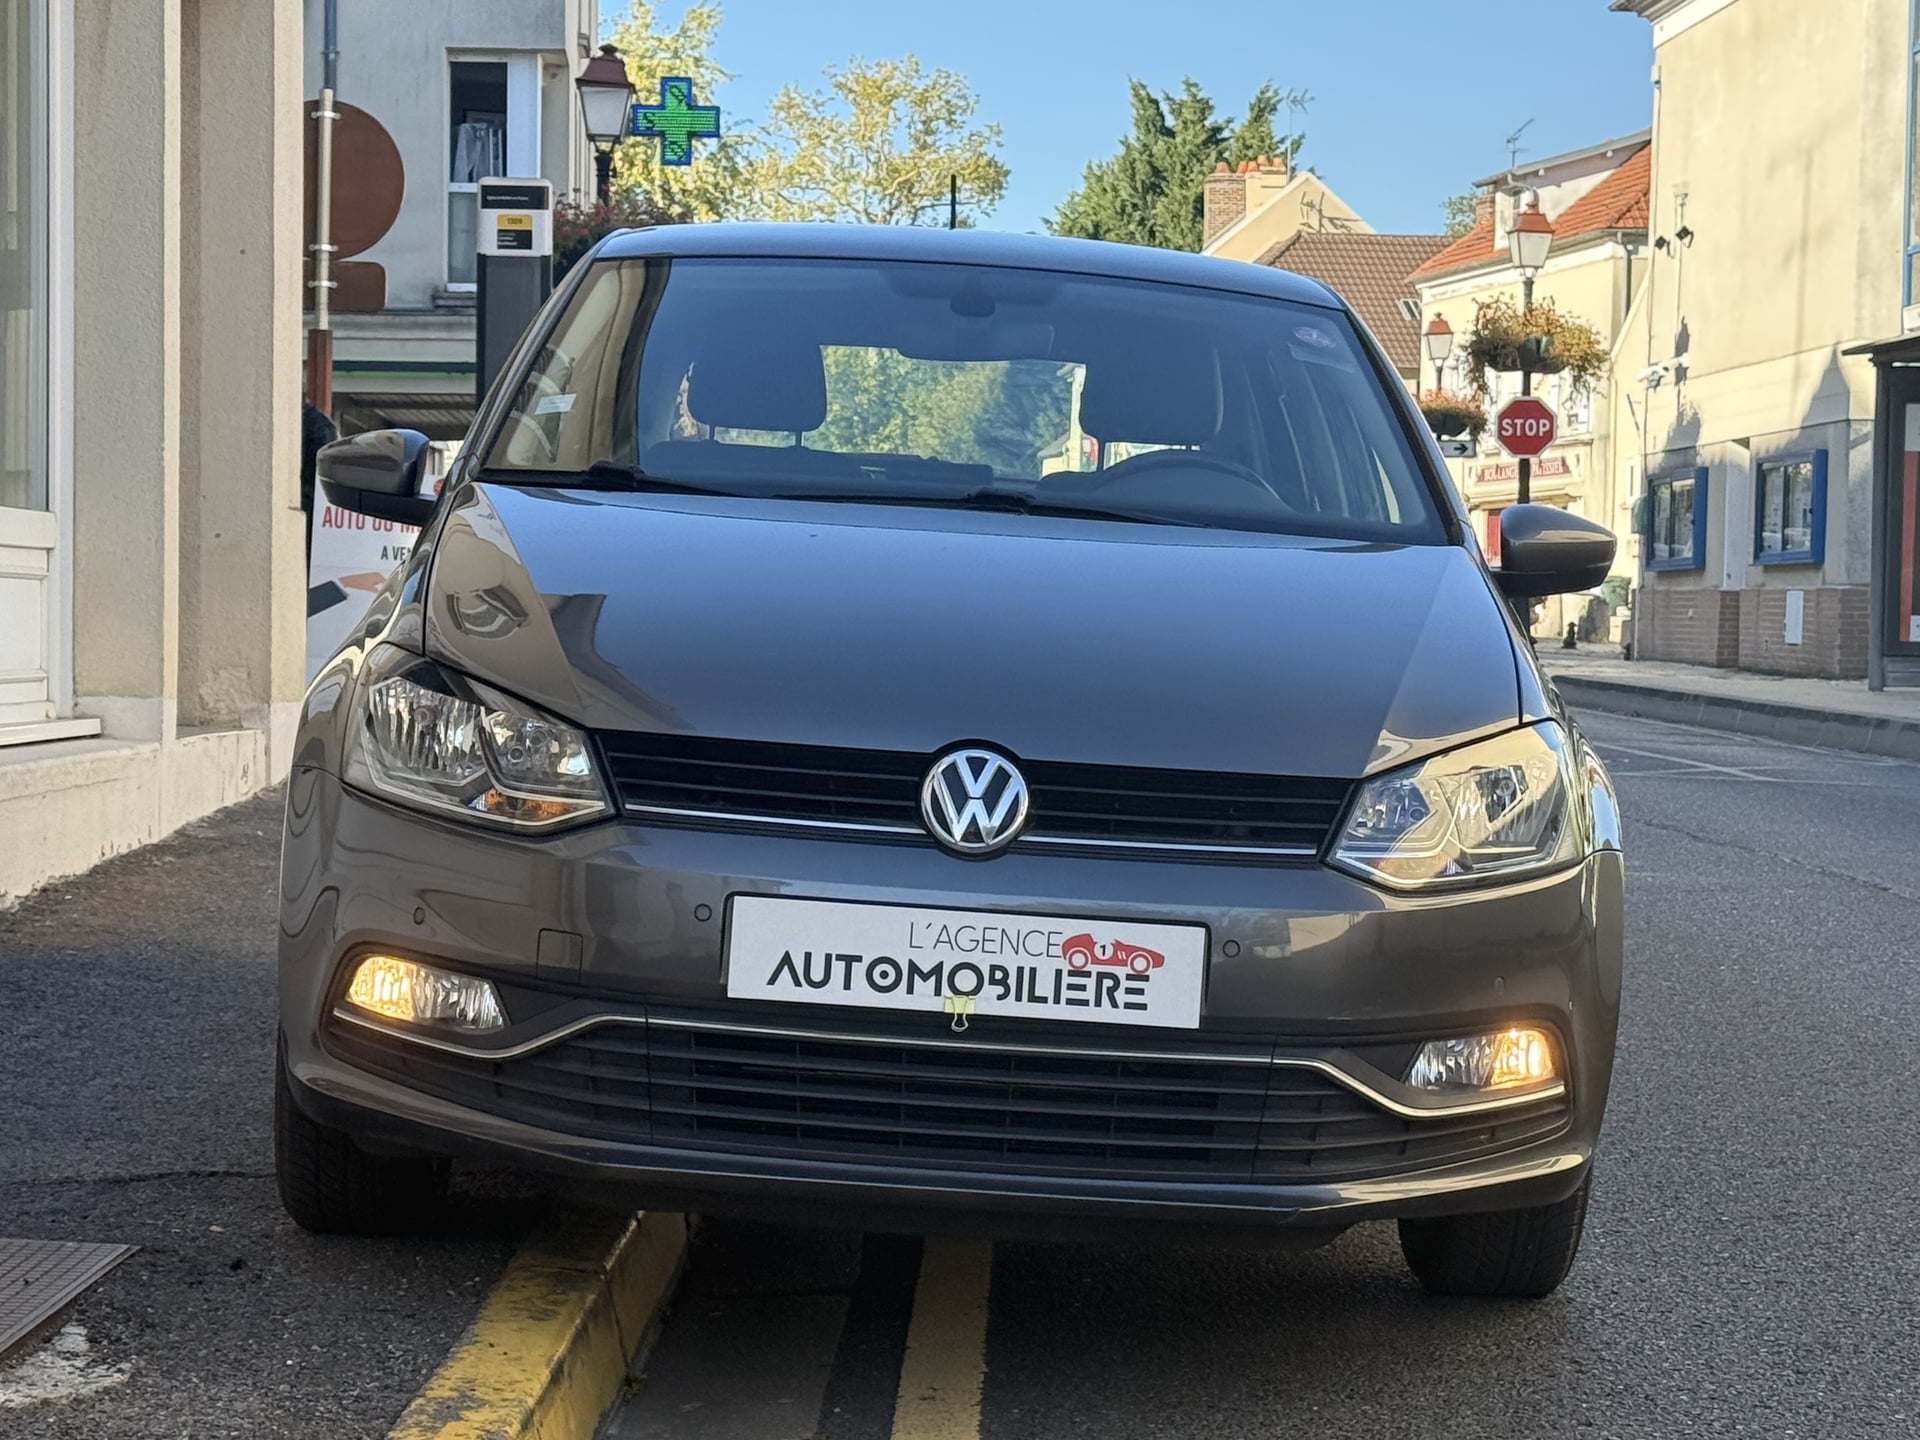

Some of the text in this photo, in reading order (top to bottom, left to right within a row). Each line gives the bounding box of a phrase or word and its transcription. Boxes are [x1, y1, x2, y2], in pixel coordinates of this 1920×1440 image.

[1501, 418, 1550, 437] STOP
[380, 545, 388, 561] A
[927, 749, 1024, 849] VW
[909, 921, 1063, 958] L'AGENCE
[1098, 944, 1107, 957] 1
[766, 950, 1150, 1011] AUTOMOBILIERE
